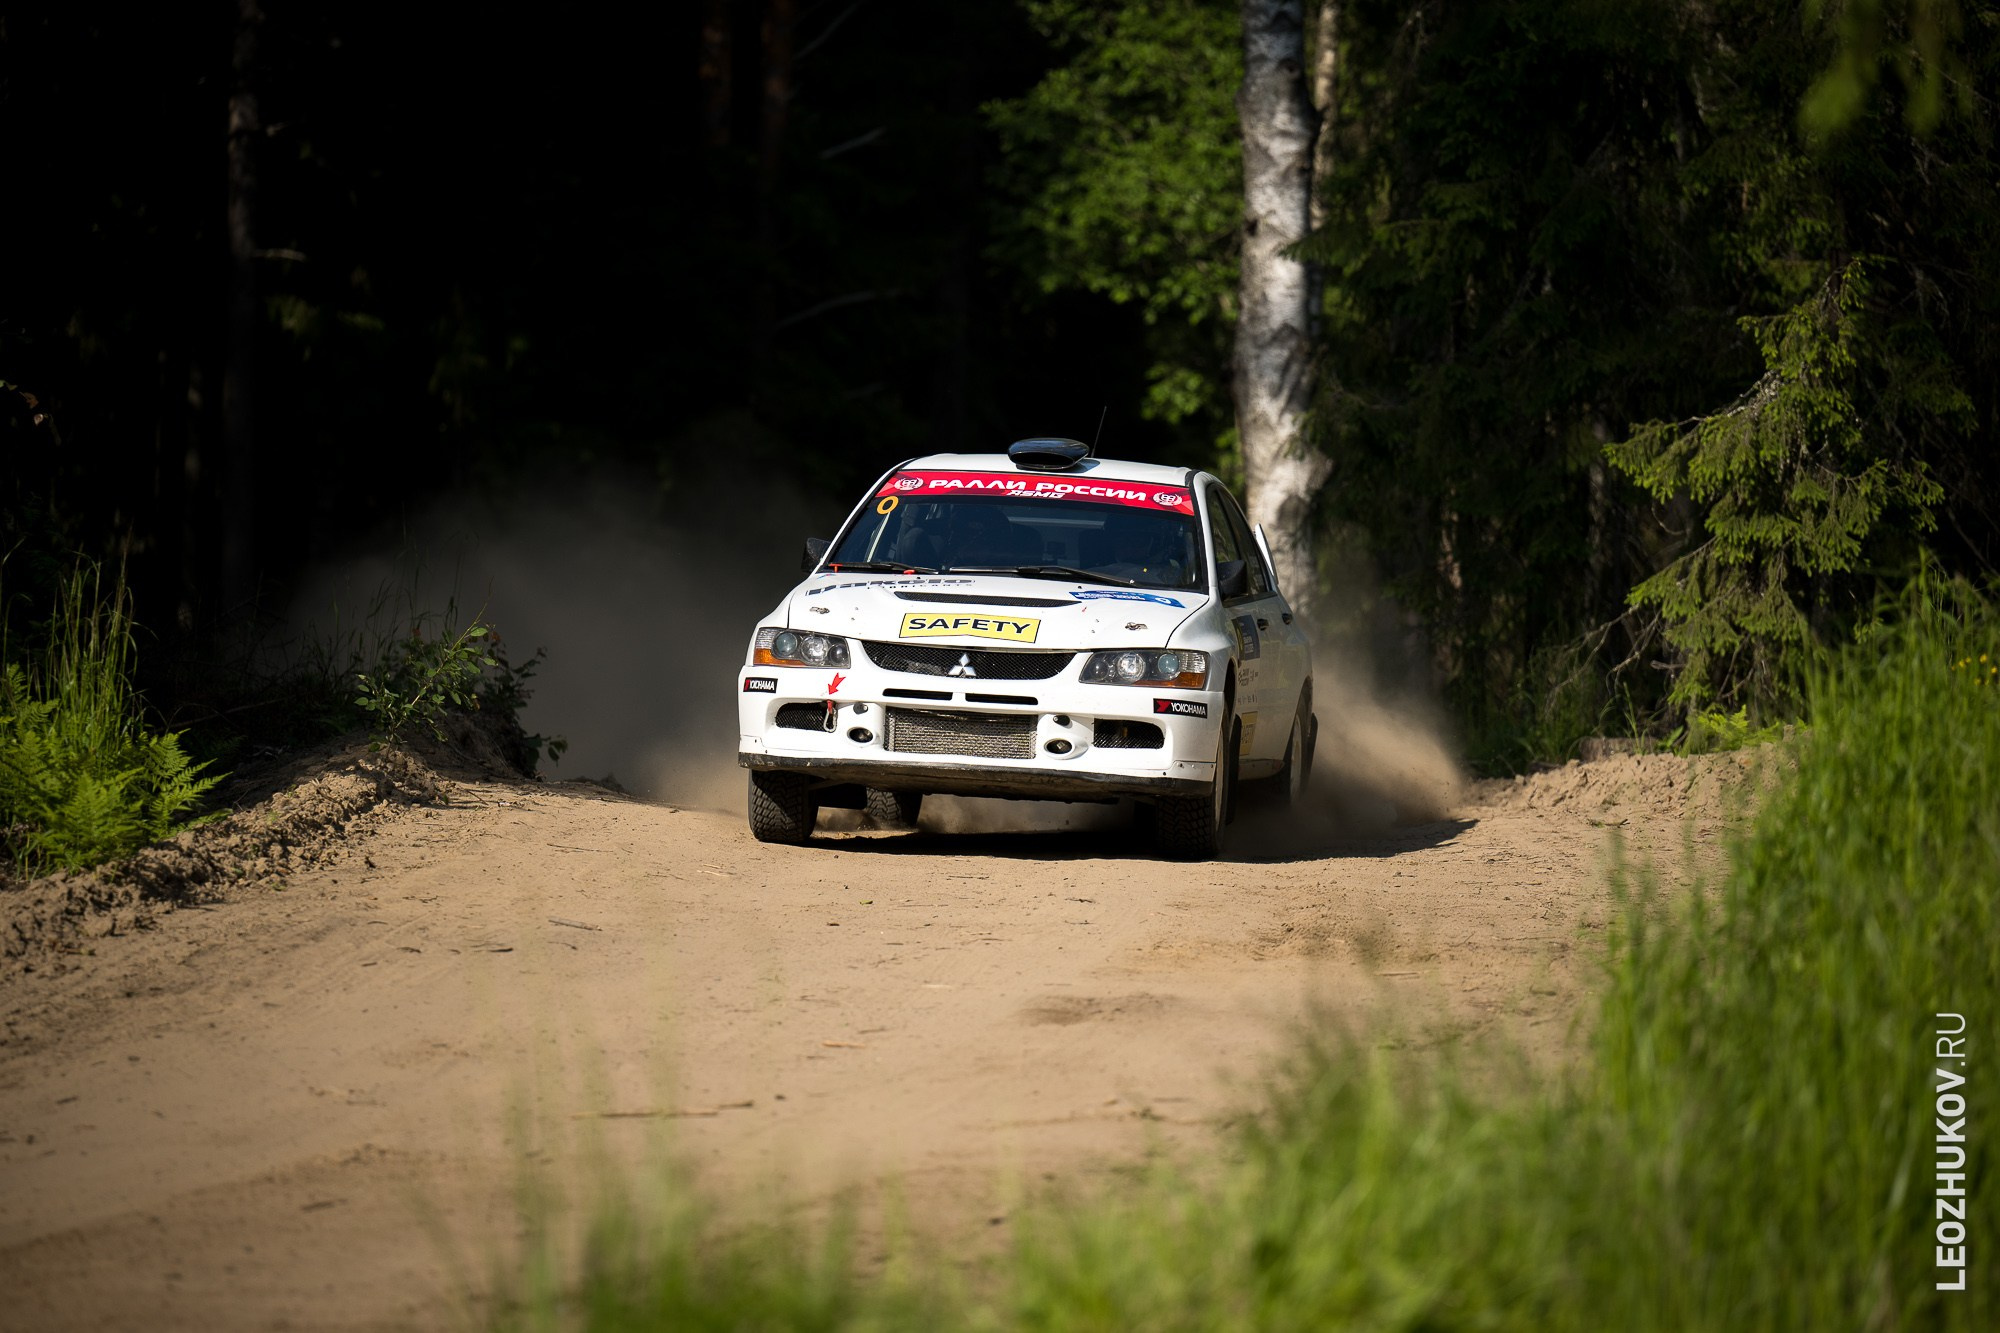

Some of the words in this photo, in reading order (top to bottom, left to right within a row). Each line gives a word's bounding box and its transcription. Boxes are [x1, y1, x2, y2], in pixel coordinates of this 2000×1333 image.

[928, 479, 1027, 491] РАЛЛИ
[1035, 482, 1147, 502] РОССИИ
[908, 618, 1031, 634] SAFETY
[1170, 702, 1207, 716] YOKOHAMA
